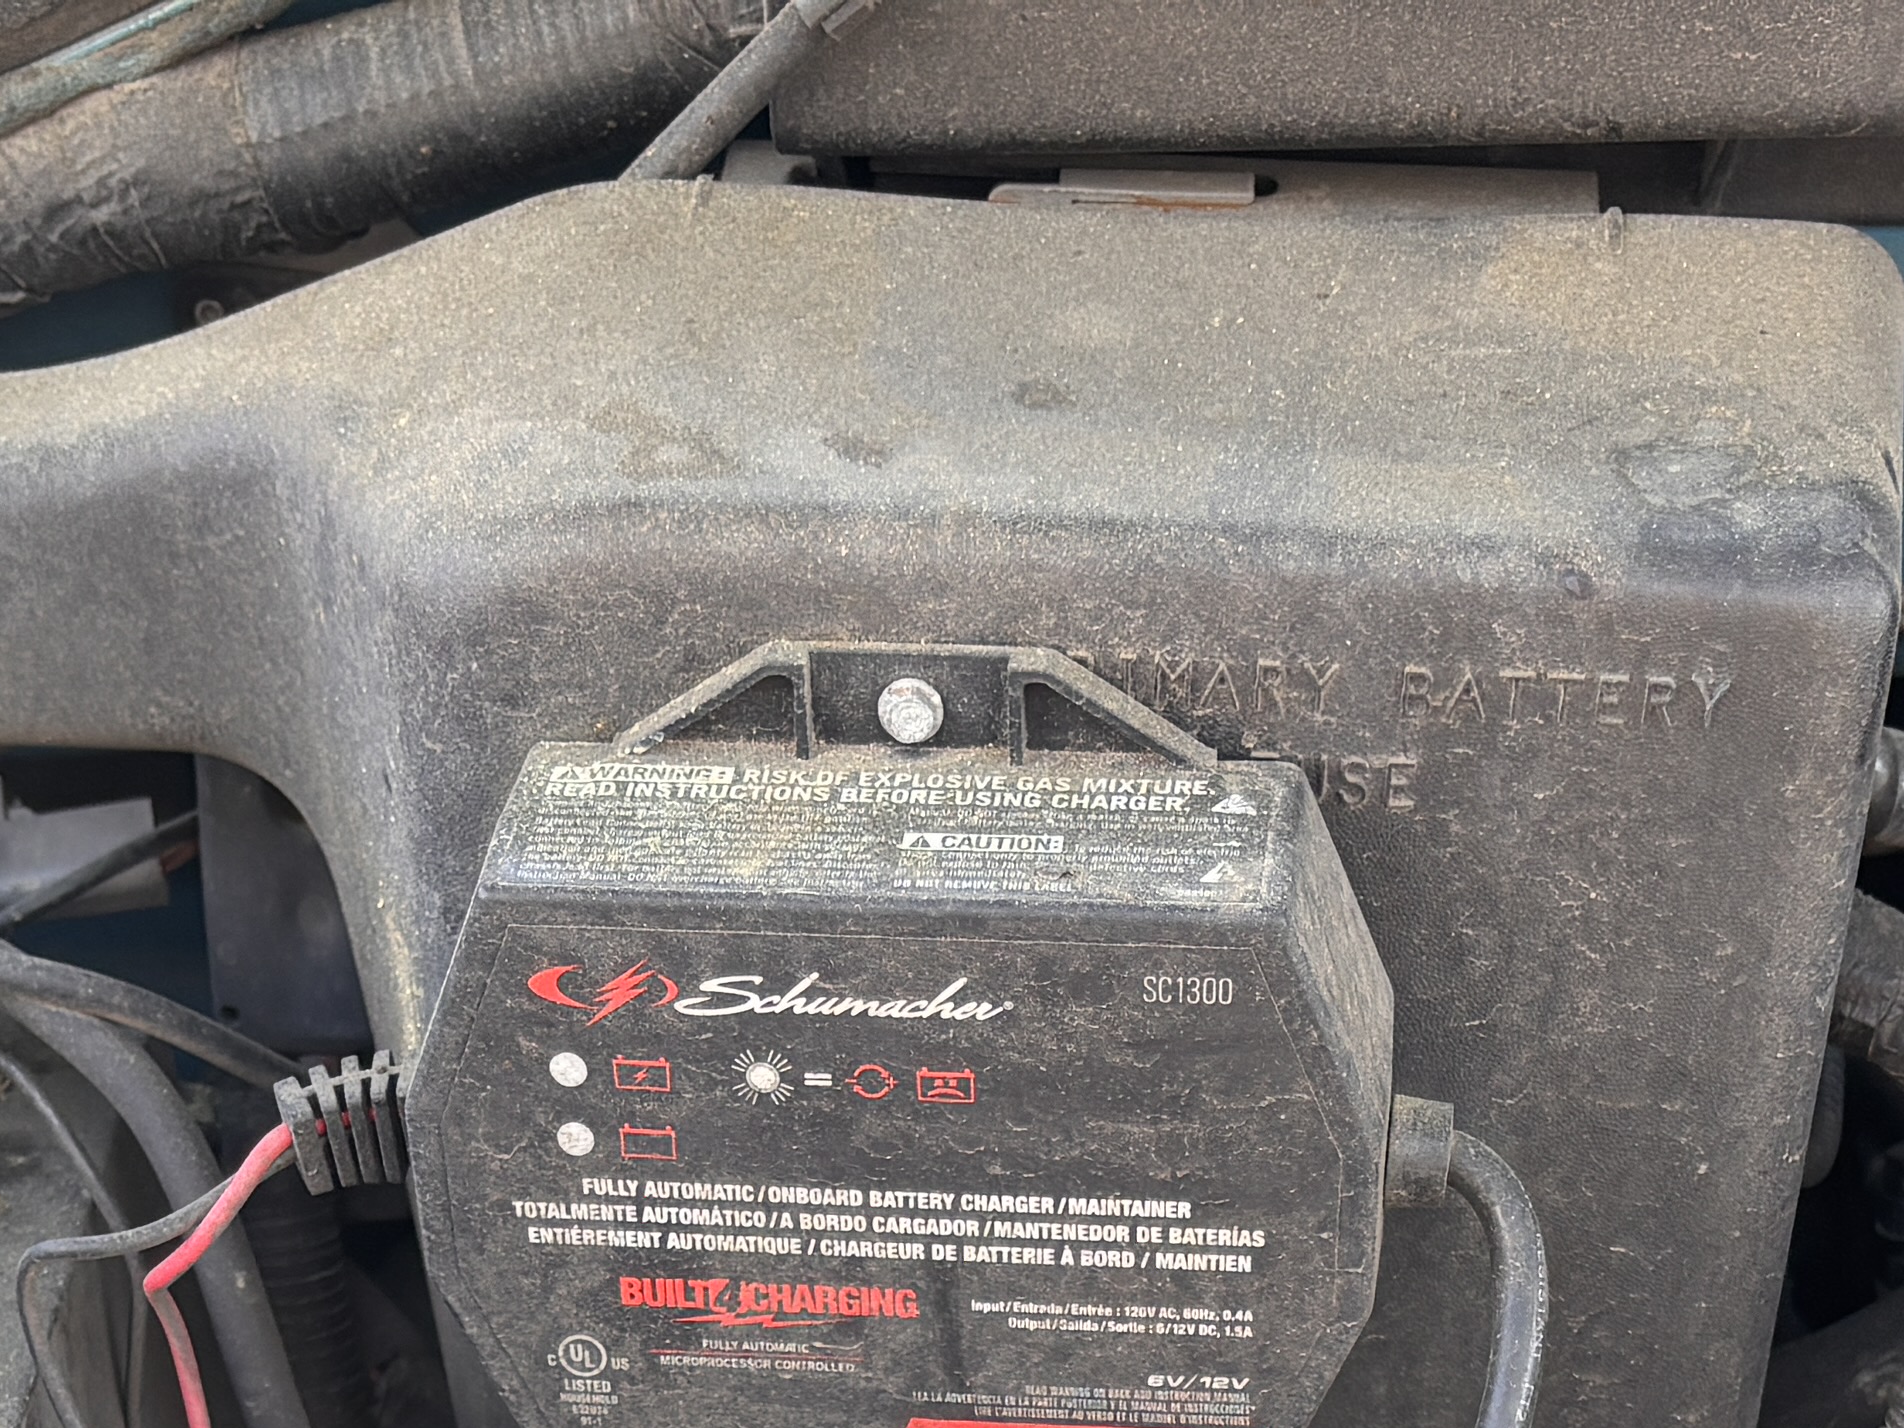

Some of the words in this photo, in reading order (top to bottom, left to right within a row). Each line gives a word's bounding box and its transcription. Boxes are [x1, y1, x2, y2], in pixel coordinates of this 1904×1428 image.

[1402, 664, 1732, 729] BATTERY
[744, 769, 805, 787] RISK
[813, 771, 853, 788] OF
[857, 771, 1007, 792] EXPLOSIVE
[1017, 775, 1072, 793] GAS
[544, 782, 616, 800] READ
[625, 783, 832, 803] INSTRUCTIONS
[838, 787, 948, 806] BEFORE
[954, 790, 1042, 810] USING
[941, 834, 1061, 853] CAUTION:
[1142, 975, 1234, 1006] SC1300
[581, 1177, 639, 1198] FULLY
[643, 1181, 755, 1203] AUTOMATIC
[868, 1190, 956, 1212] BATTERY
[960, 1193, 1054, 1215] CHARGER
[512, 1201, 639, 1224] TOTALMENTE
[641, 1205, 767, 1230] AUTOMÁTICO
[799, 1212, 867, 1233] BORDO
[872, 1215, 980, 1238] CARGADOR
[1136, 1225, 1163, 1245] DE
[1168, 1223, 1266, 1249] BATERÍAS
[666, 1232, 802, 1256] AUTOMATIQUE
[819, 1238, 925, 1261] CHARGEUR
[931, 1243, 958, 1262] DE
[963, 1245, 1056, 1266] BATTERIE
[1060, 1245, 1075, 1267] À
[1080, 1250, 1136, 1269] BORD
[1155, 1253, 1252, 1274] MAINTIEN
[1222, 1309, 1254, 1322] 0.4A
[1224, 1325, 1254, 1339] 1.5A
[569, 1344, 596, 1368] UL
[611, 1357, 631, 1371] US
[701, 1338, 739, 1351] FULLY
[741, 1341, 810, 1354] AUTOMATIC
[659, 1354, 772, 1371] MICROPROCESSOR
[564, 1378, 612, 1394] LISTED
[1146, 1375, 1251, 1390] 6V/12V
